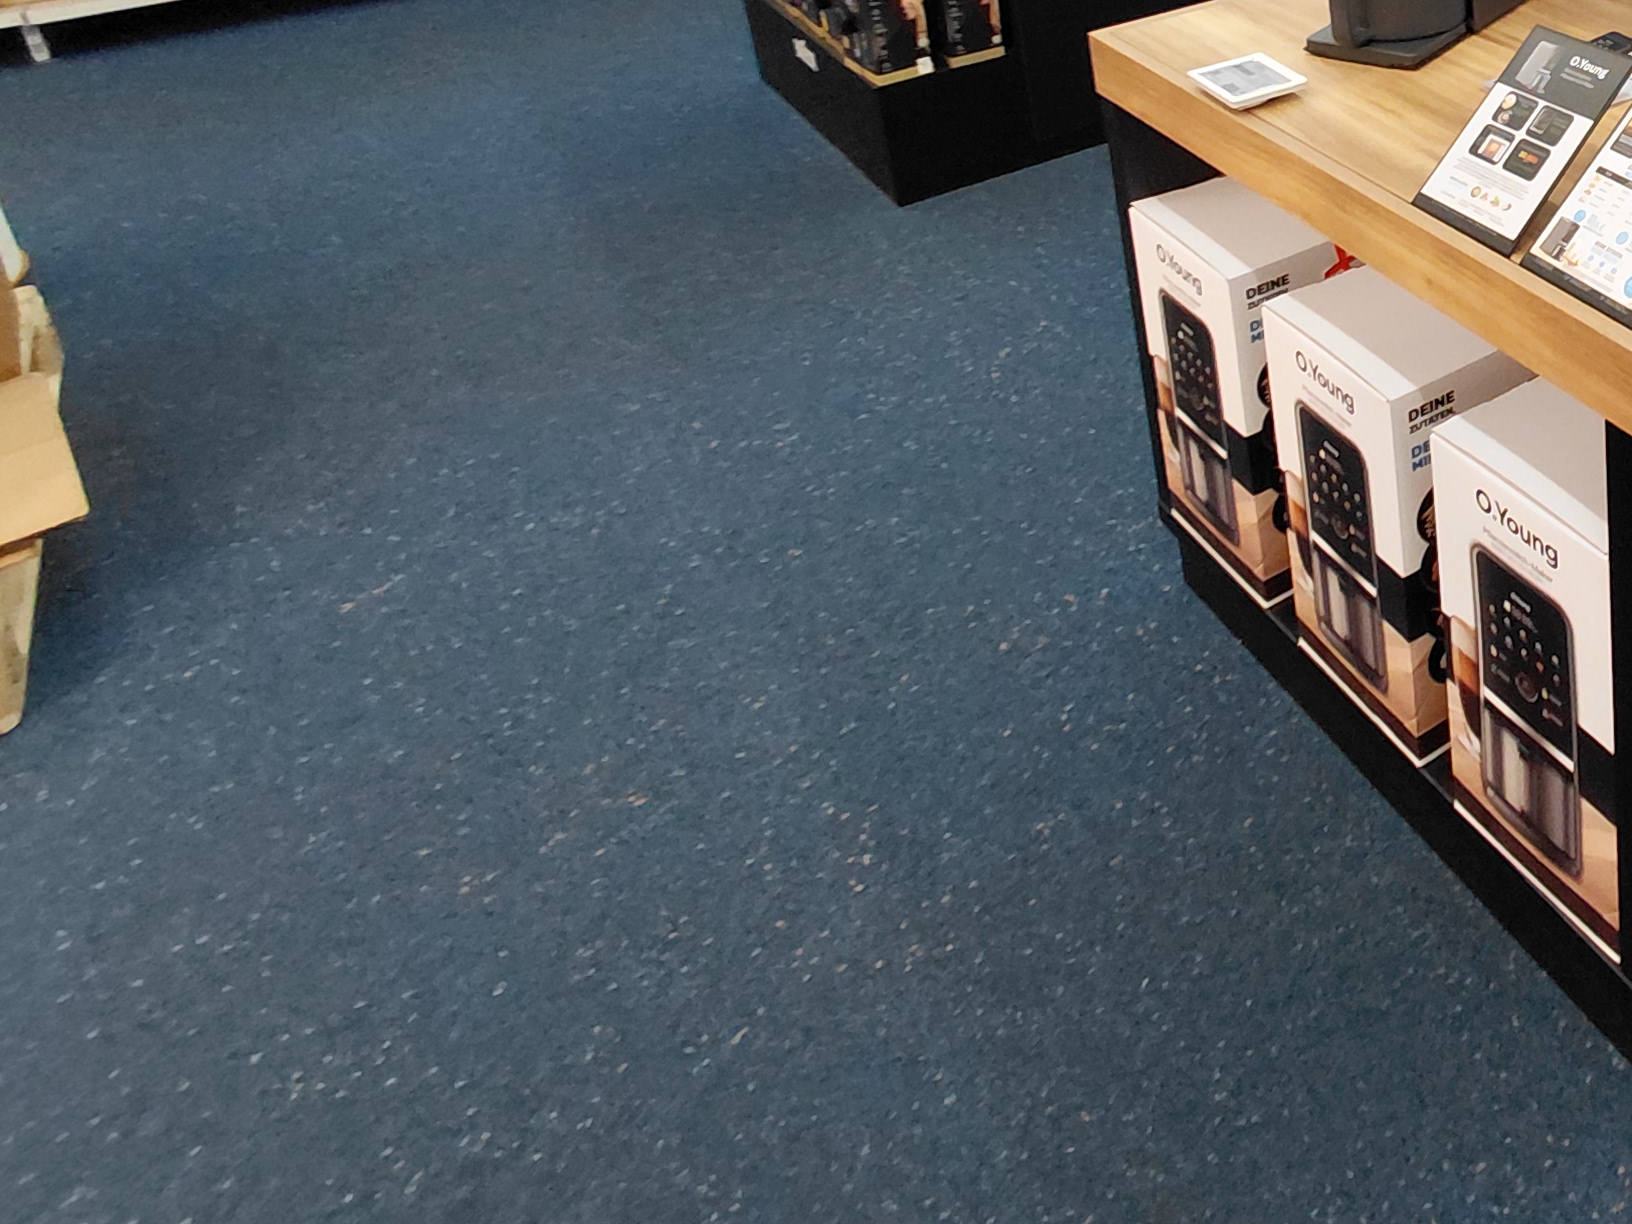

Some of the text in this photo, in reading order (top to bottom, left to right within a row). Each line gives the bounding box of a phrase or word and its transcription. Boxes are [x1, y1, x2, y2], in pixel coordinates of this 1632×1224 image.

[1569, 55, 1610, 81] O.Young
[1245, 273, 1291, 300] DEINE
[1295, 350, 1355, 416] O.Young
[1408, 389, 1456, 424] DEINE
[1475, 488, 1559, 570] O.Young
